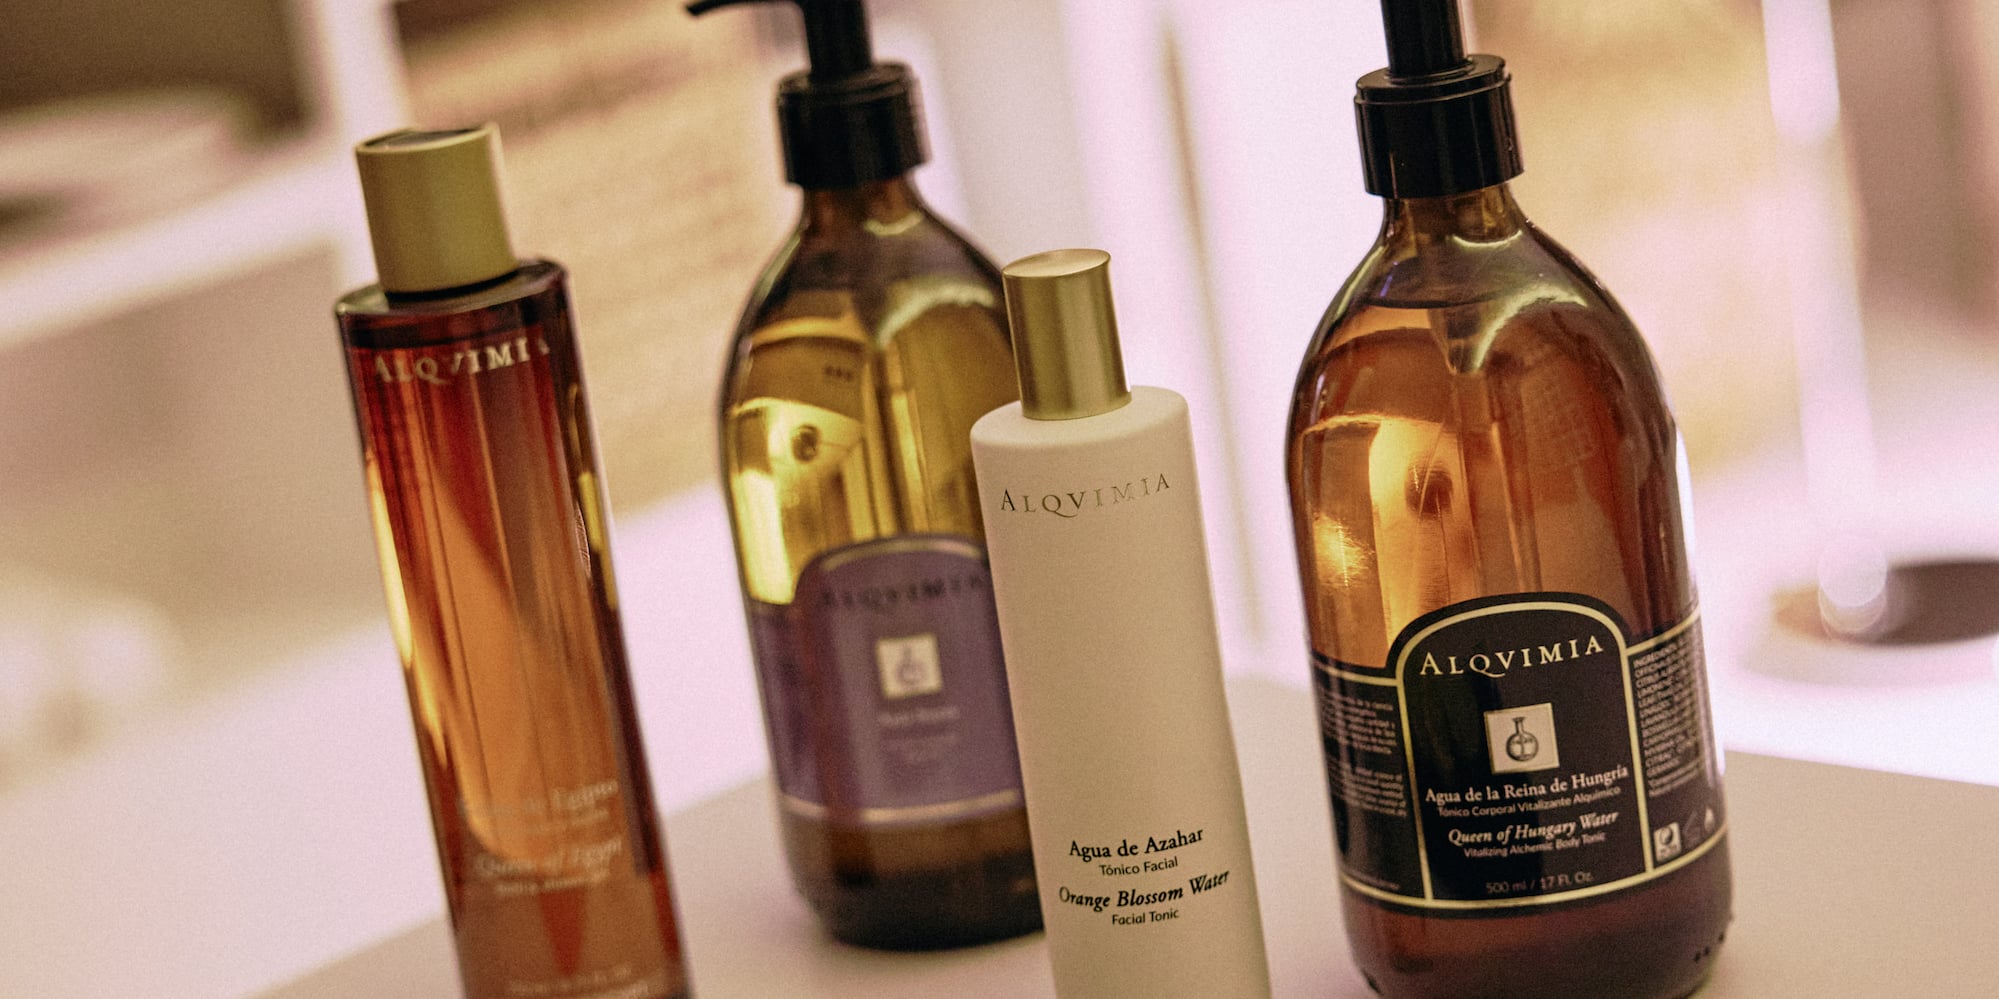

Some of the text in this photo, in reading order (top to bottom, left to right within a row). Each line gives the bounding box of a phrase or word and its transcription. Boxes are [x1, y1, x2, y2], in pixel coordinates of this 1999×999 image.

[1000, 473, 1170, 518] ALQVIMIA
[1419, 634, 1604, 678] ALQVIMIA
[1425, 764, 1629, 806] Agua de la Reina de Hungría
[1472, 802, 1516, 817] Corporal
[1518, 797, 1571, 812] Vitalizante
[1448, 811, 1619, 846] Queen of Hungary Water
[1463, 831, 1606, 859] Vitalizing Alchemic Body Tonic
[1069, 829, 1203, 863] Agua de Azahar
[1099, 856, 1178, 876] Tónico Facial
[1059, 870, 1230, 912] Orange Blossom Water
[1486, 882, 1509, 895] 500
[1512, 879, 1527, 891] ml
[1539, 876, 1554, 891] 17
[1112, 908, 1180, 925] Facial Tonic
